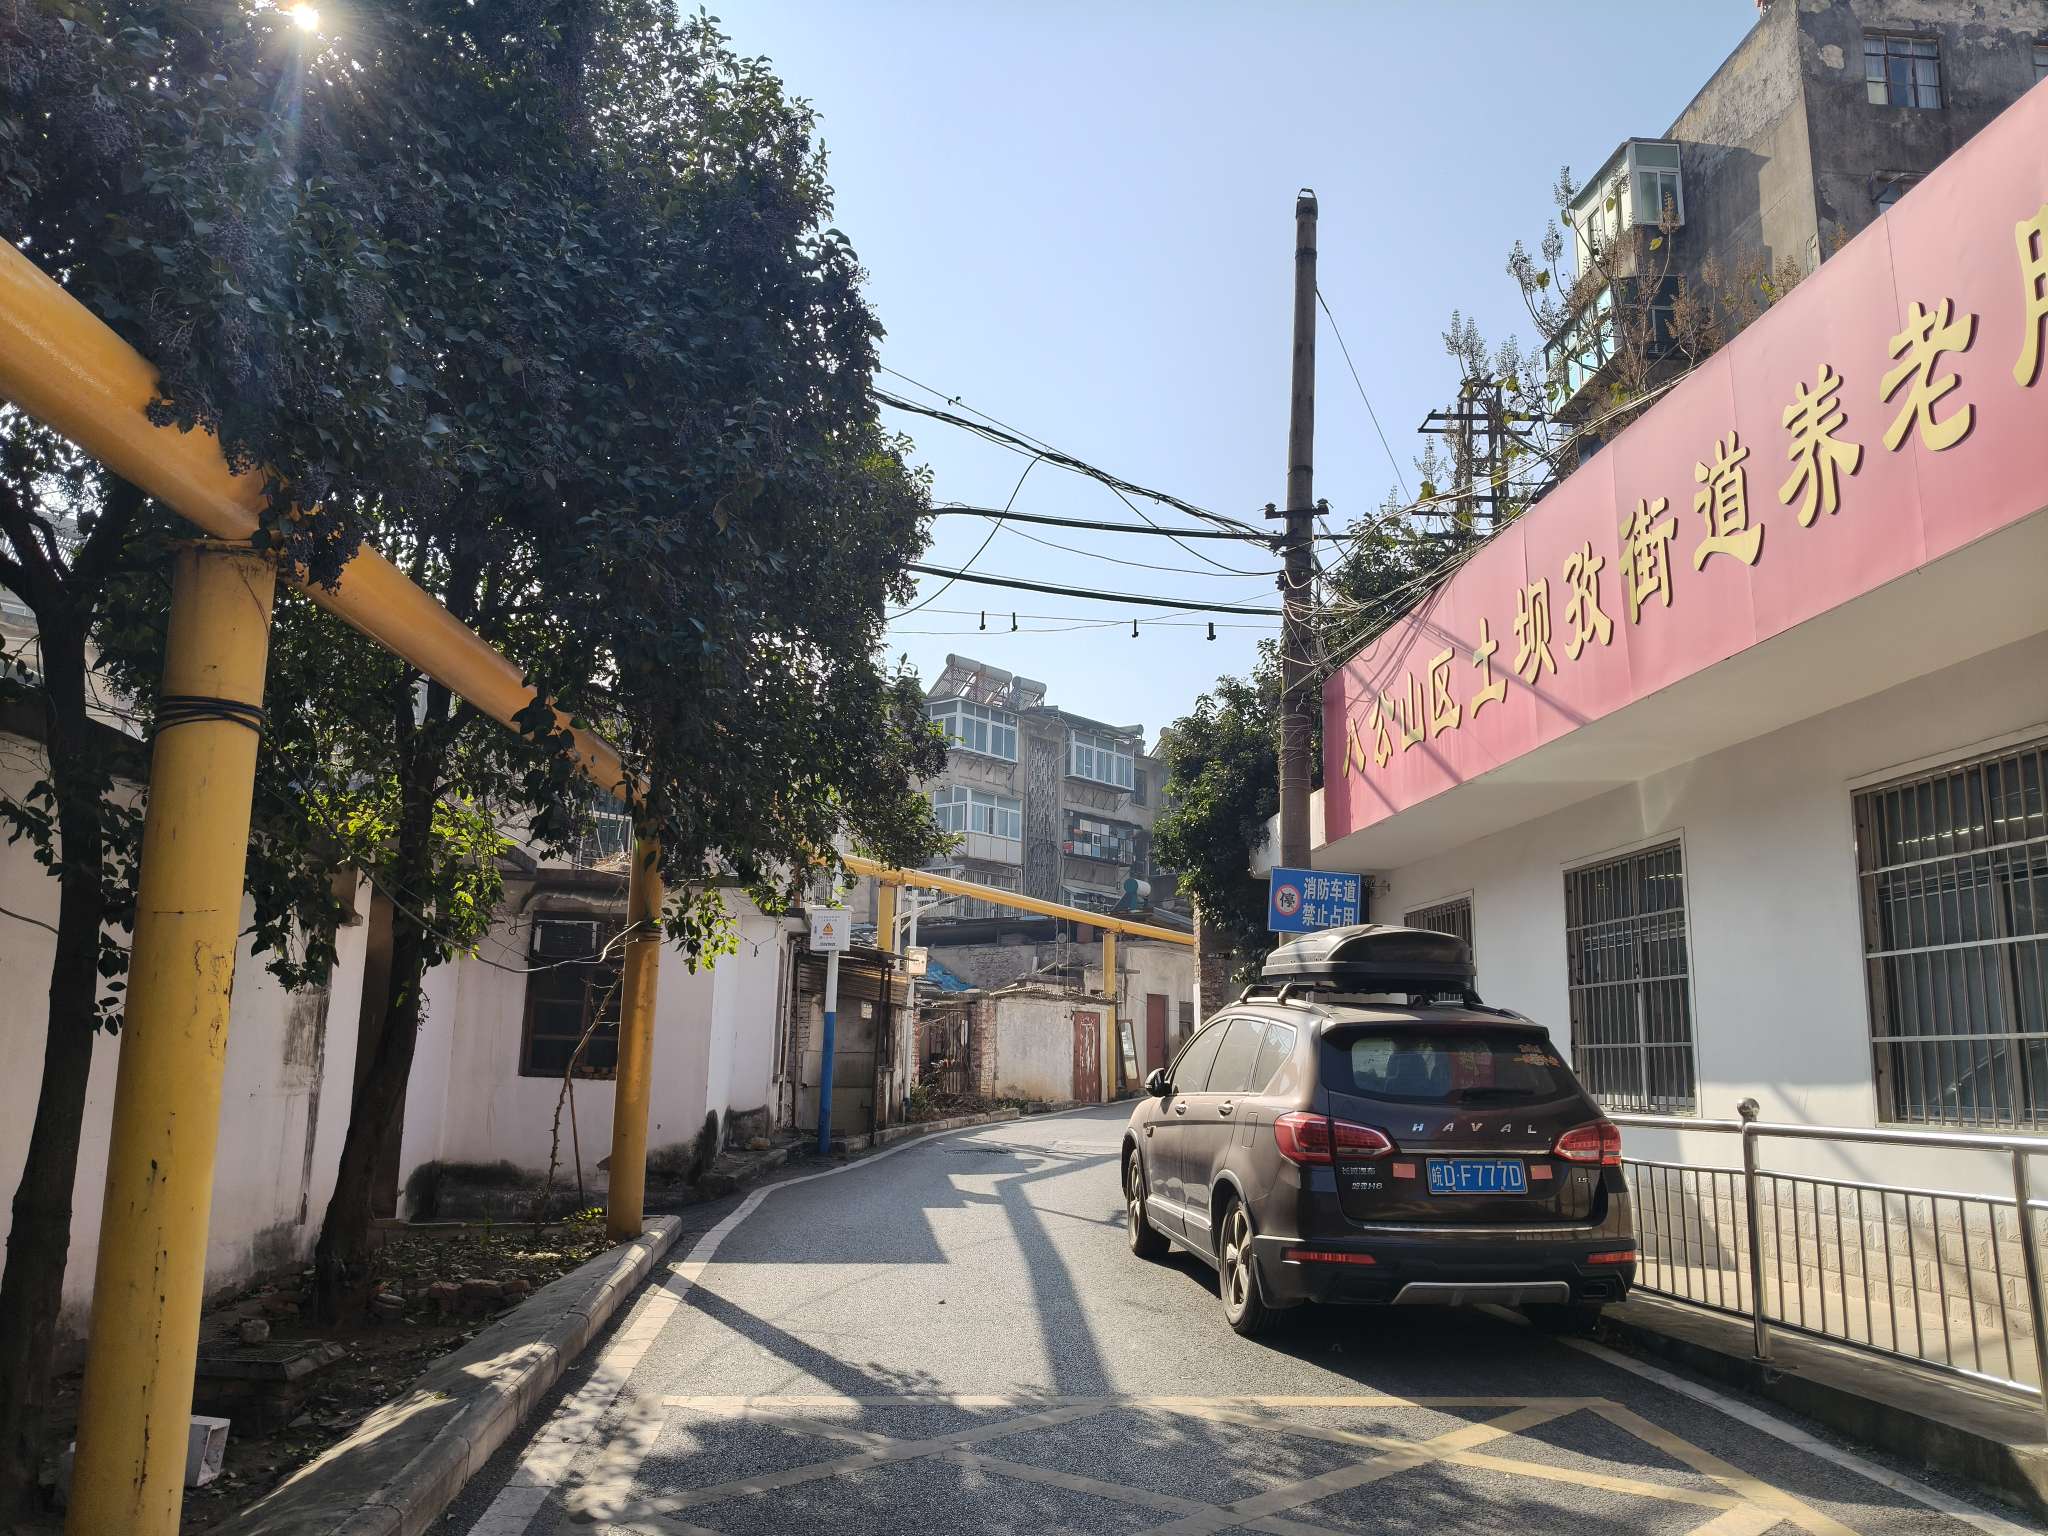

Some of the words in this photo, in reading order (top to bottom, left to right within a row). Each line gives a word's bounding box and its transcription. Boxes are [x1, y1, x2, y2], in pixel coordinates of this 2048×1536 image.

[1280, 891, 1296, 908] 停
[1303, 876, 1357, 903] 消防车道
[1302, 902, 1355, 928] 禁止占用
[1411, 1122, 1537, 1134] HAVAL
